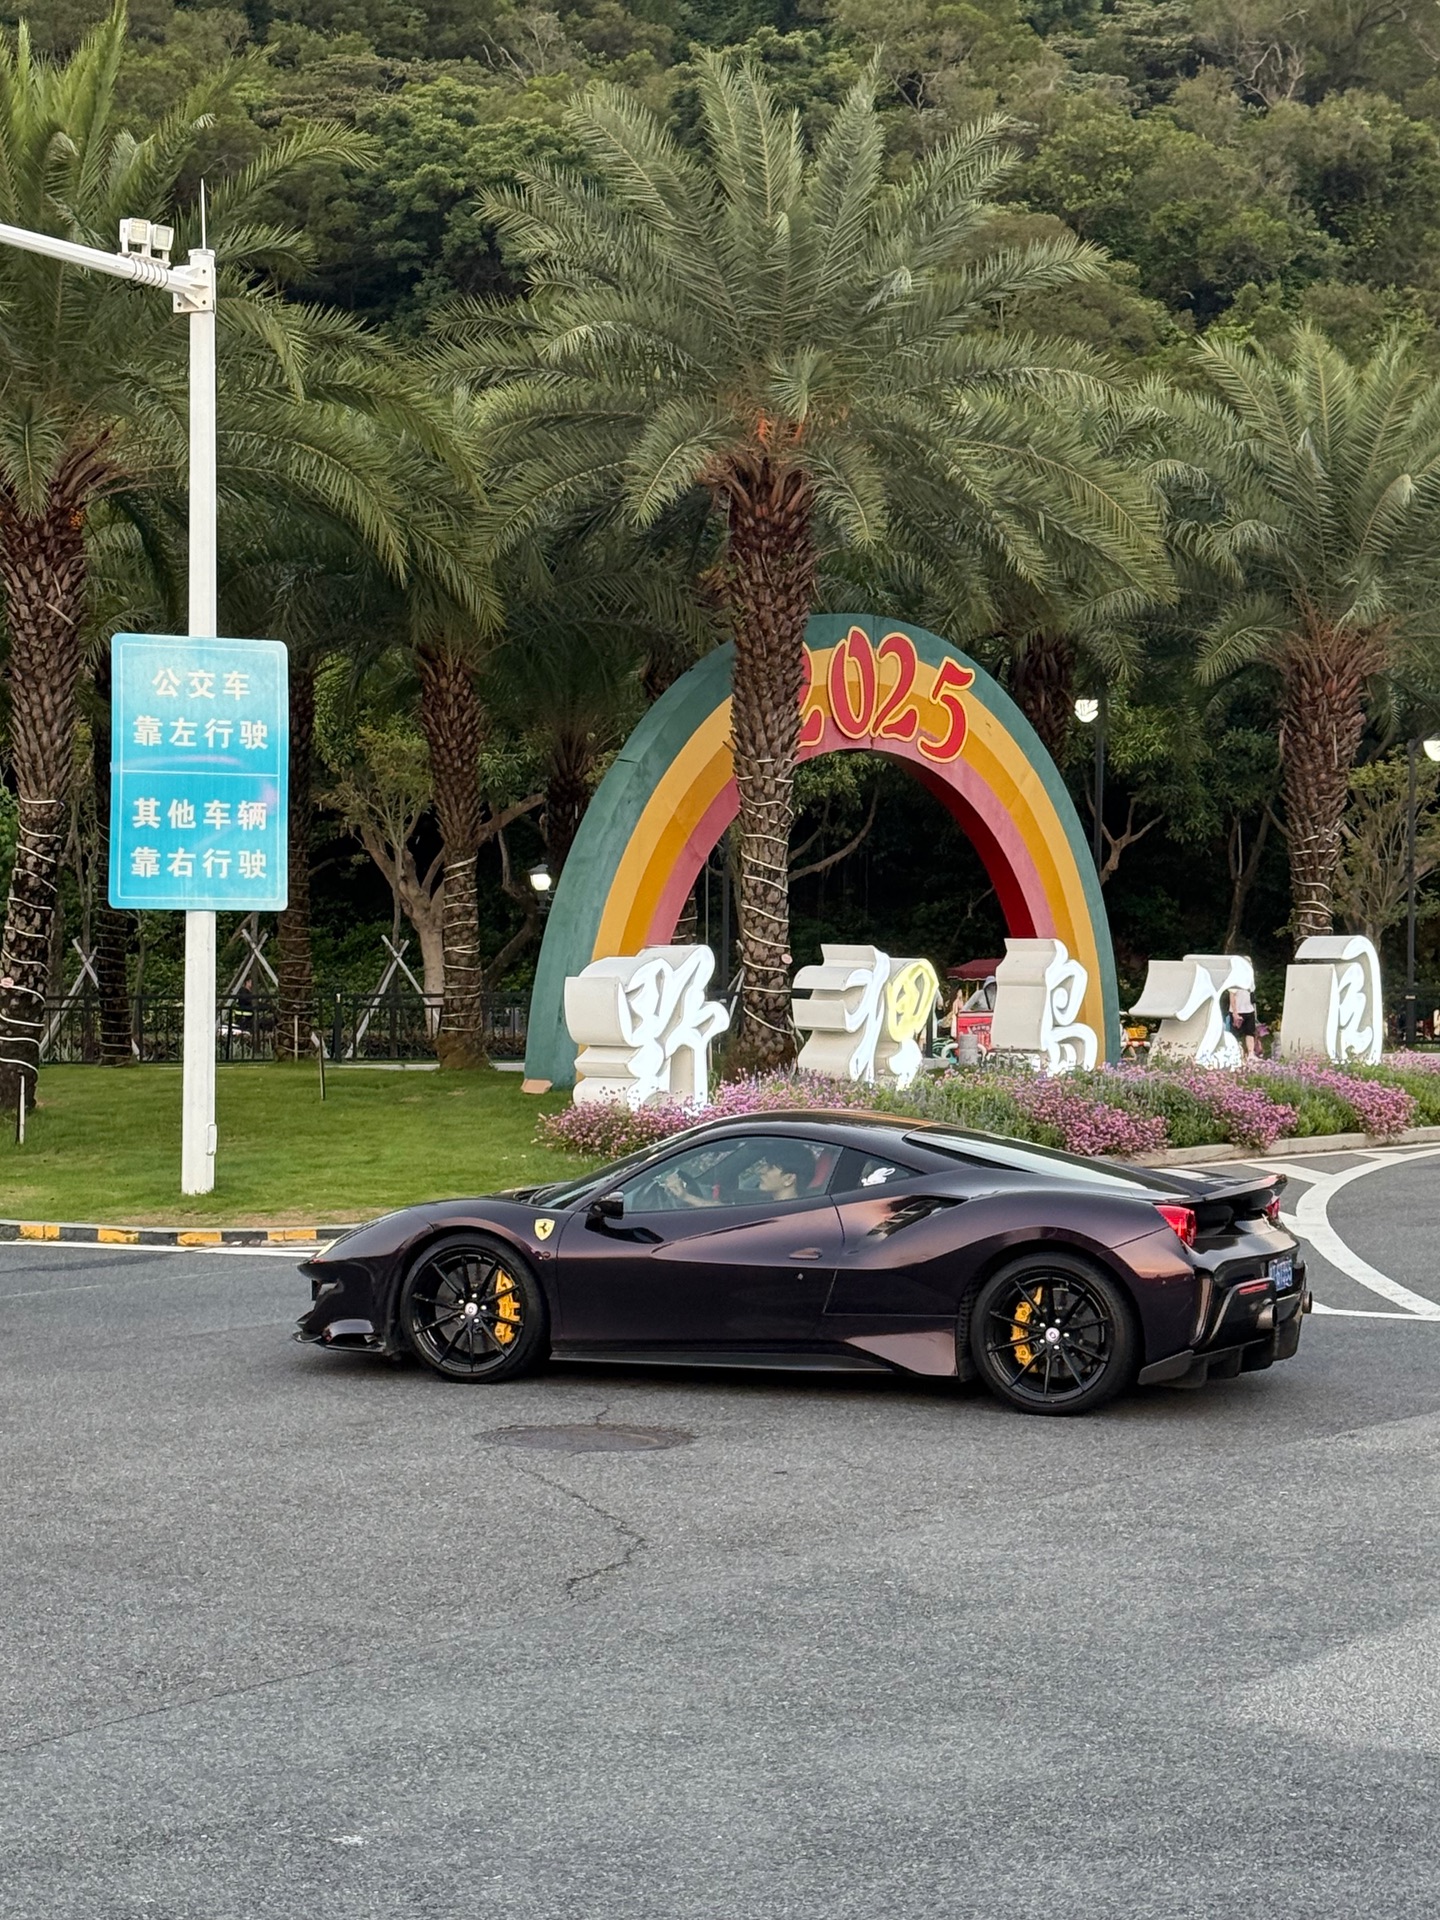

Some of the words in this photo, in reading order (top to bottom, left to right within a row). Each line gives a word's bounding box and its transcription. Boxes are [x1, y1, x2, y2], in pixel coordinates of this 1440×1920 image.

[152, 668, 251, 700] 公交车
[133, 715, 269, 750] 靠左行驶
[132, 797, 267, 830] 其他车辆
[130, 846, 267, 879] 靠右行驶
